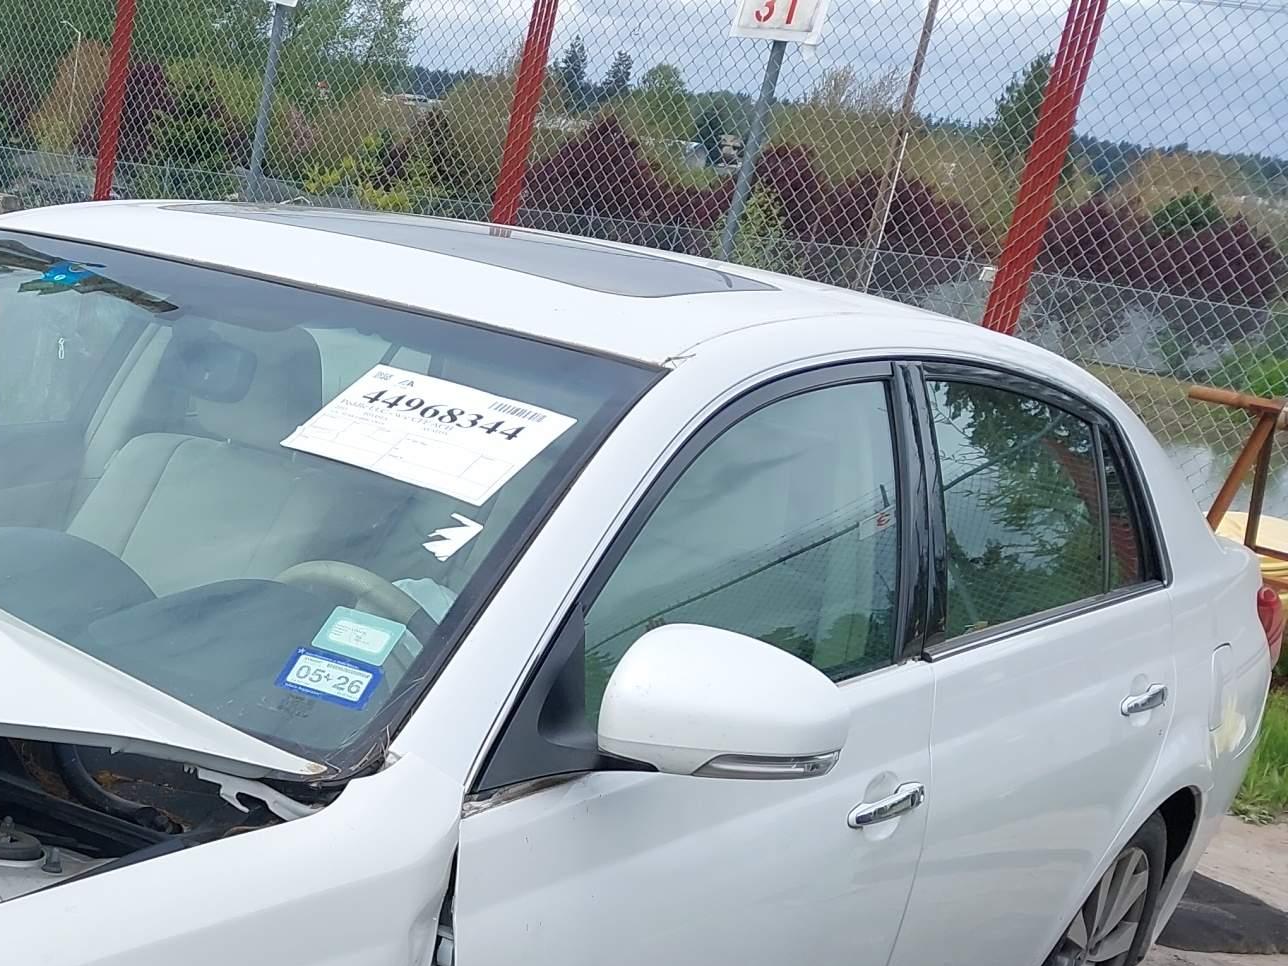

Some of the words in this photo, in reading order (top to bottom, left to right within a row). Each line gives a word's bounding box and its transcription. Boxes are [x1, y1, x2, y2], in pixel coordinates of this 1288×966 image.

[362, 389, 526, 441] 44968344
[295, 665, 325, 683] 05
[332, 675, 363, 694] 26
